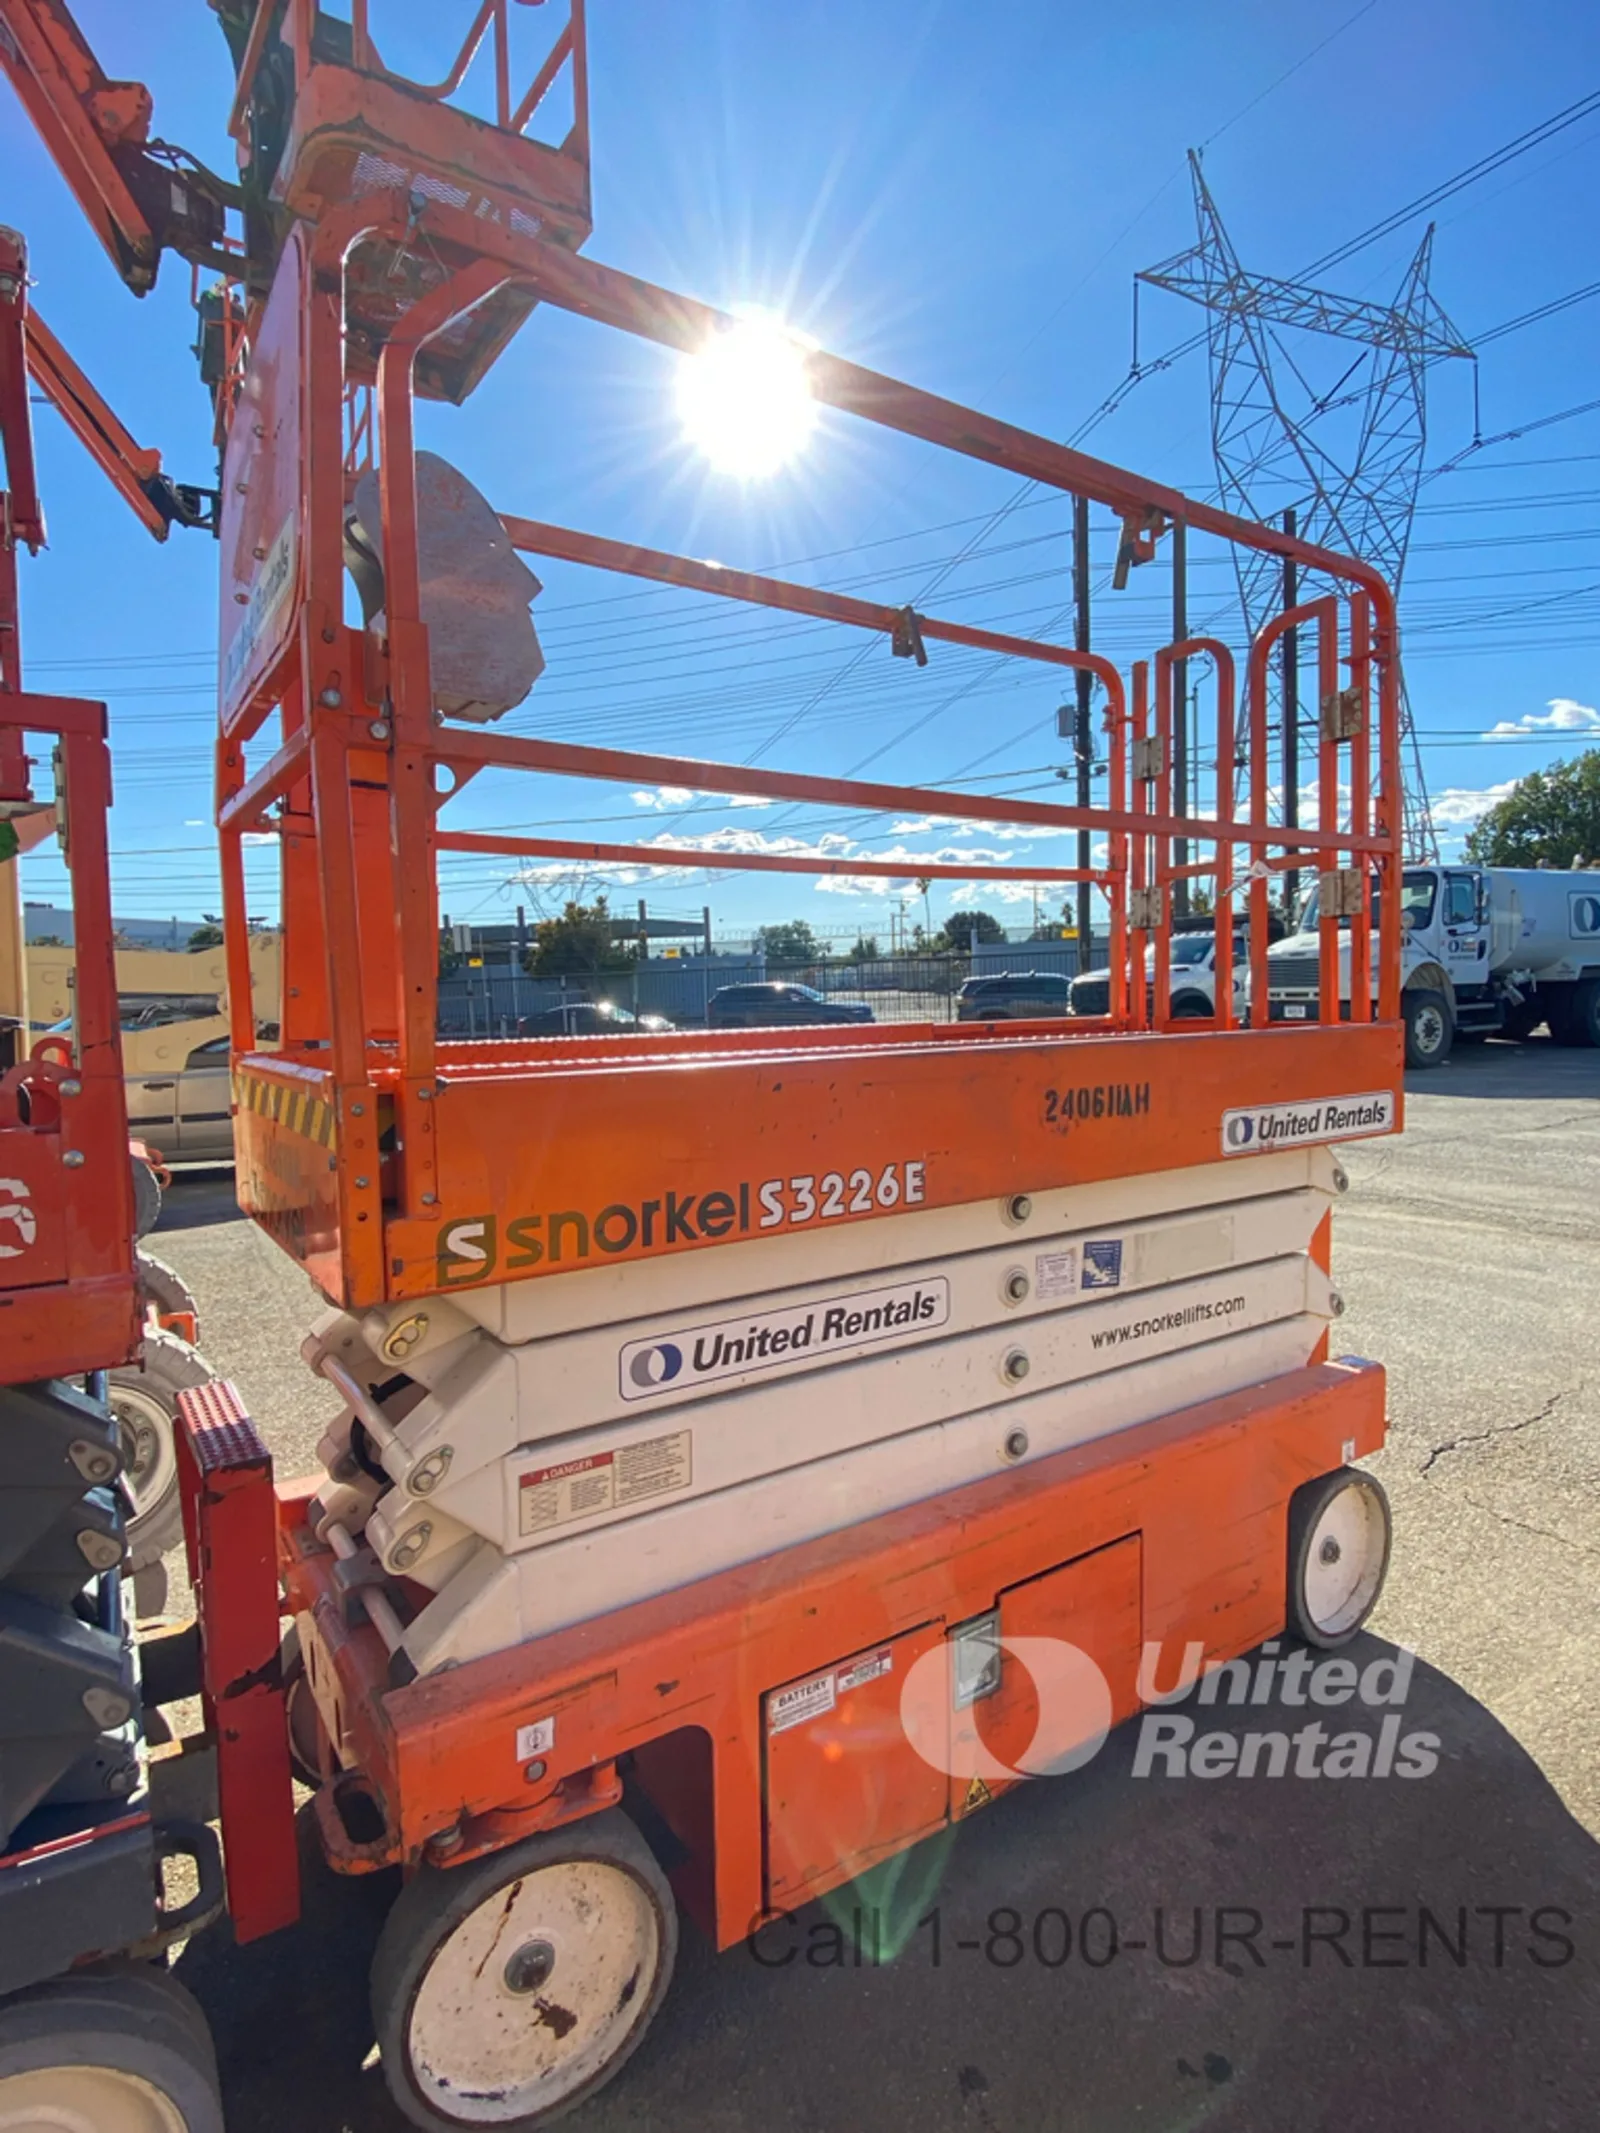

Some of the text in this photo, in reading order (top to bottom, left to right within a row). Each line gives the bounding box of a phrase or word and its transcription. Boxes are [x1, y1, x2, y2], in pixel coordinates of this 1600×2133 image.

[1257, 1100, 1386, 1141] United Rentals
[506, 1182, 749, 1269] snorkel
[758, 1160, 925, 1229] S3226E
[693, 1291, 936, 1372] United Rentals
[1091, 1296, 1246, 1349] www.snorkellifts.com
[549, 1458, 594, 1479] DANGER
[778, 1678, 828, 1708] BATTERY
